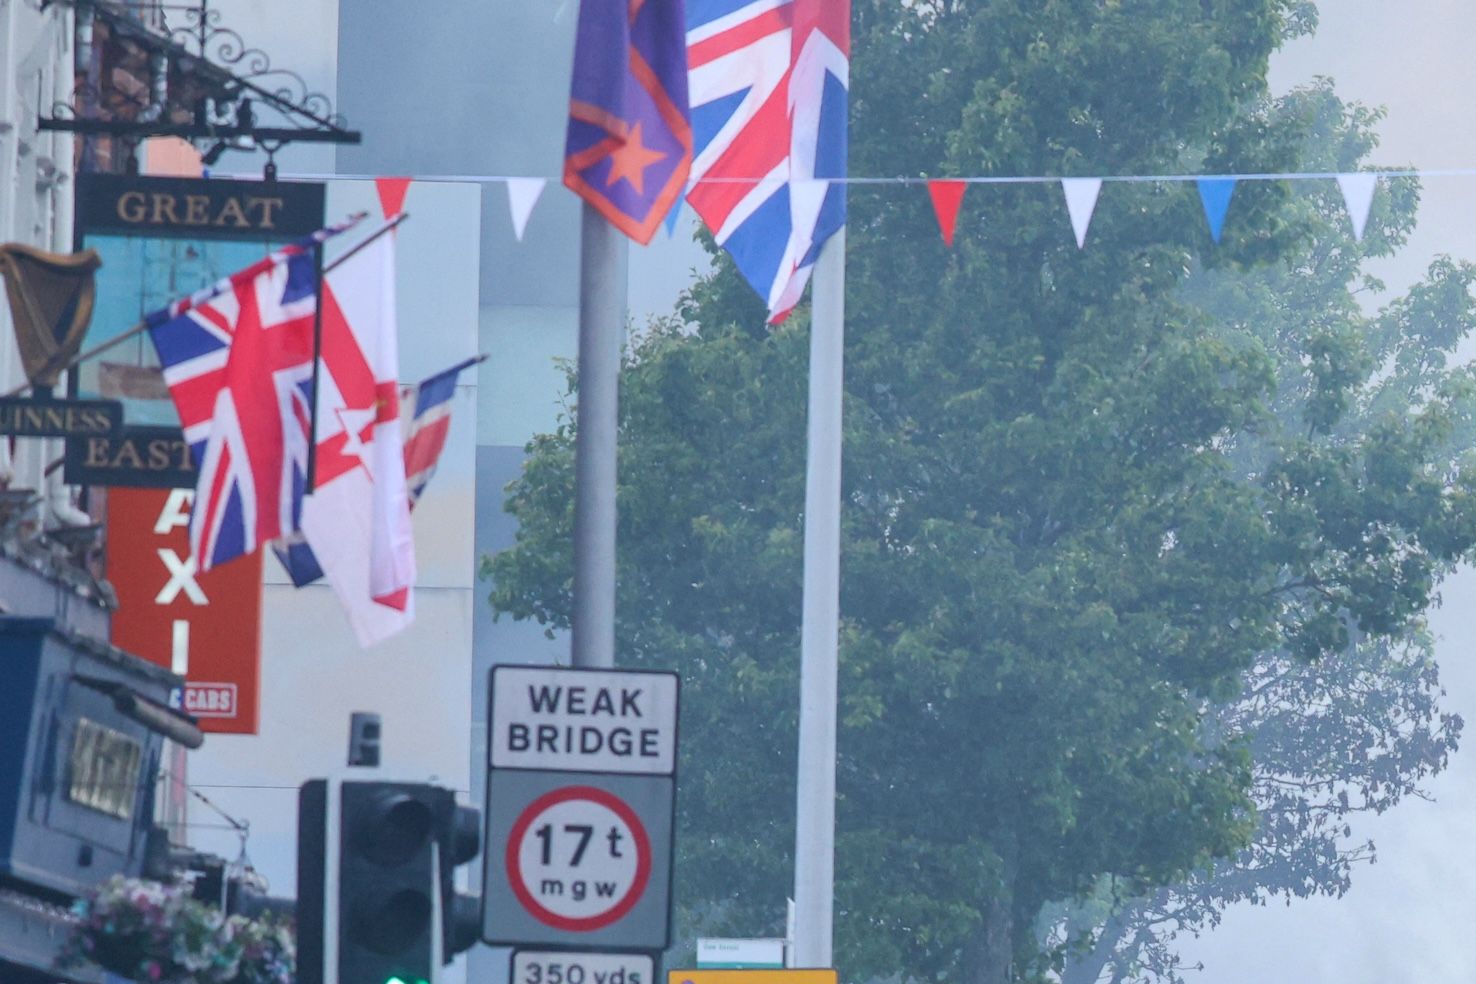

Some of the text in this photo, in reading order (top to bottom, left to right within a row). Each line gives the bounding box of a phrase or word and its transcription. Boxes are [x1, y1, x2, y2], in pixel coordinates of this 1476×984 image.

[117, 193, 283, 229] GREAT
[529, 685, 643, 717] WEAK
[508, 722, 660, 757] BRIDGE
[535, 823, 622, 867] 17 t
